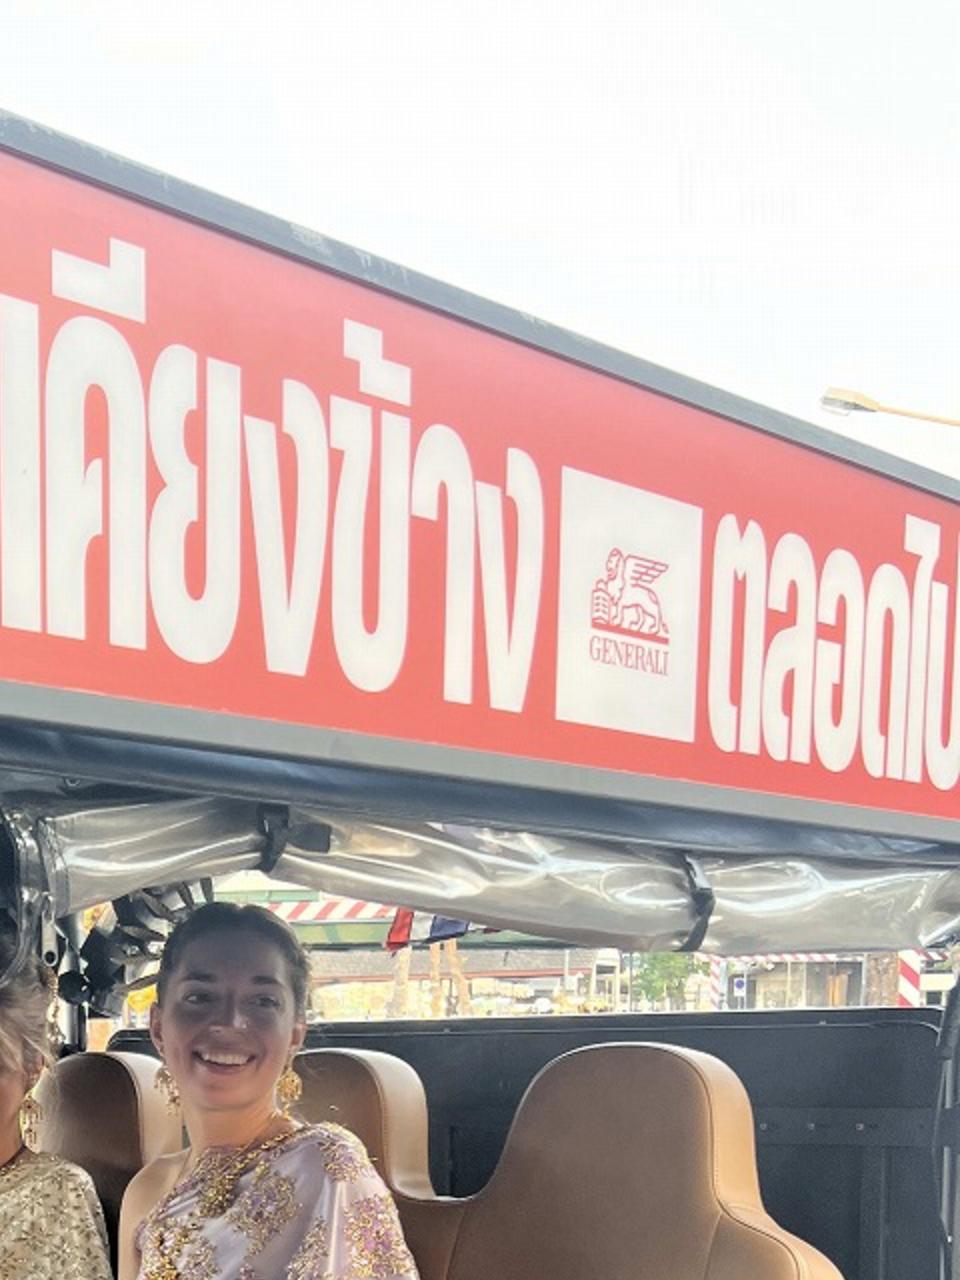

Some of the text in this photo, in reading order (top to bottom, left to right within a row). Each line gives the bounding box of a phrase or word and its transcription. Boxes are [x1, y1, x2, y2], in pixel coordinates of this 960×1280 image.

[589, 635, 669, 677] GENERALI
[709, 513, 960, 790] ตลอดไป
